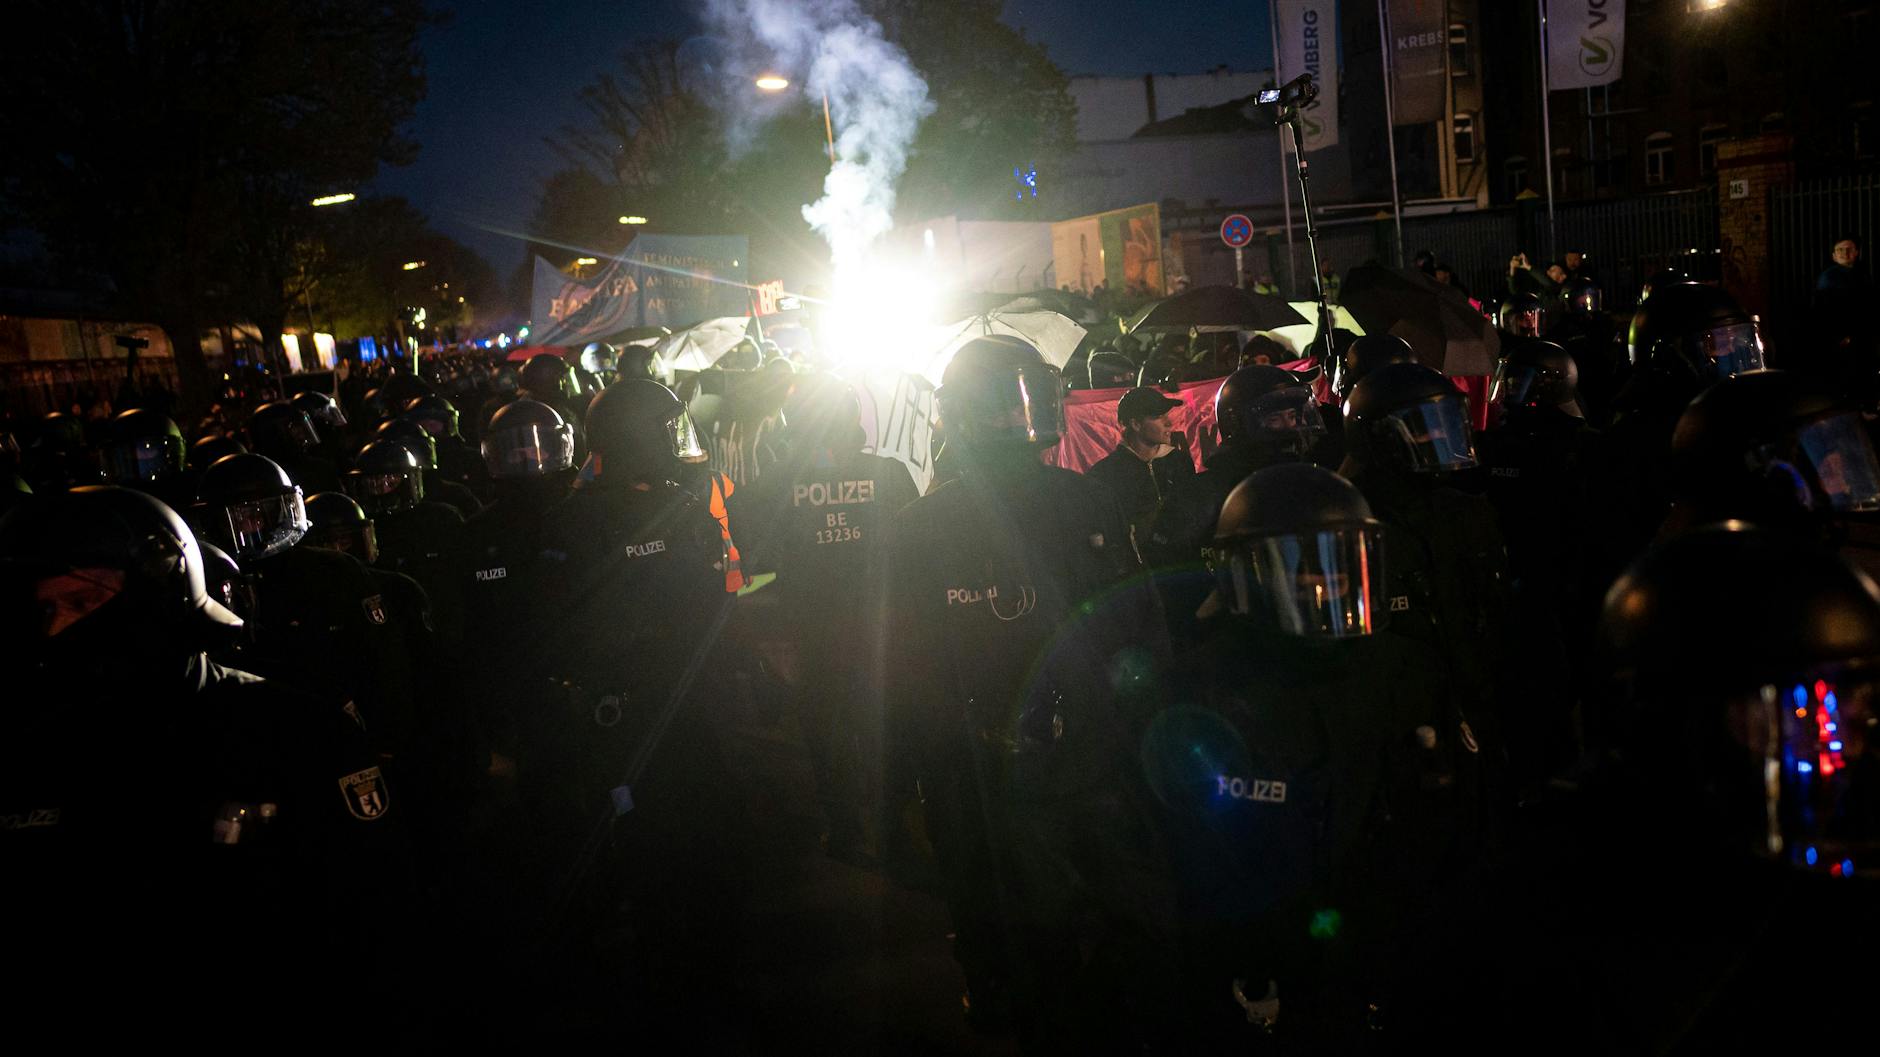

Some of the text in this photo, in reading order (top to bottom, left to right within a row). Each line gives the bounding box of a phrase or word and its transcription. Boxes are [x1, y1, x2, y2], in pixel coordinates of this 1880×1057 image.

[1303, 9, 1320, 111] VMBERG
[793, 480, 875, 507] POLIZEI
[826, 512, 847, 527] BE
[816, 526, 861, 544] 13236
[626, 540, 666, 558] POLIZEI
[476, 567, 507, 581] POLIZEI
